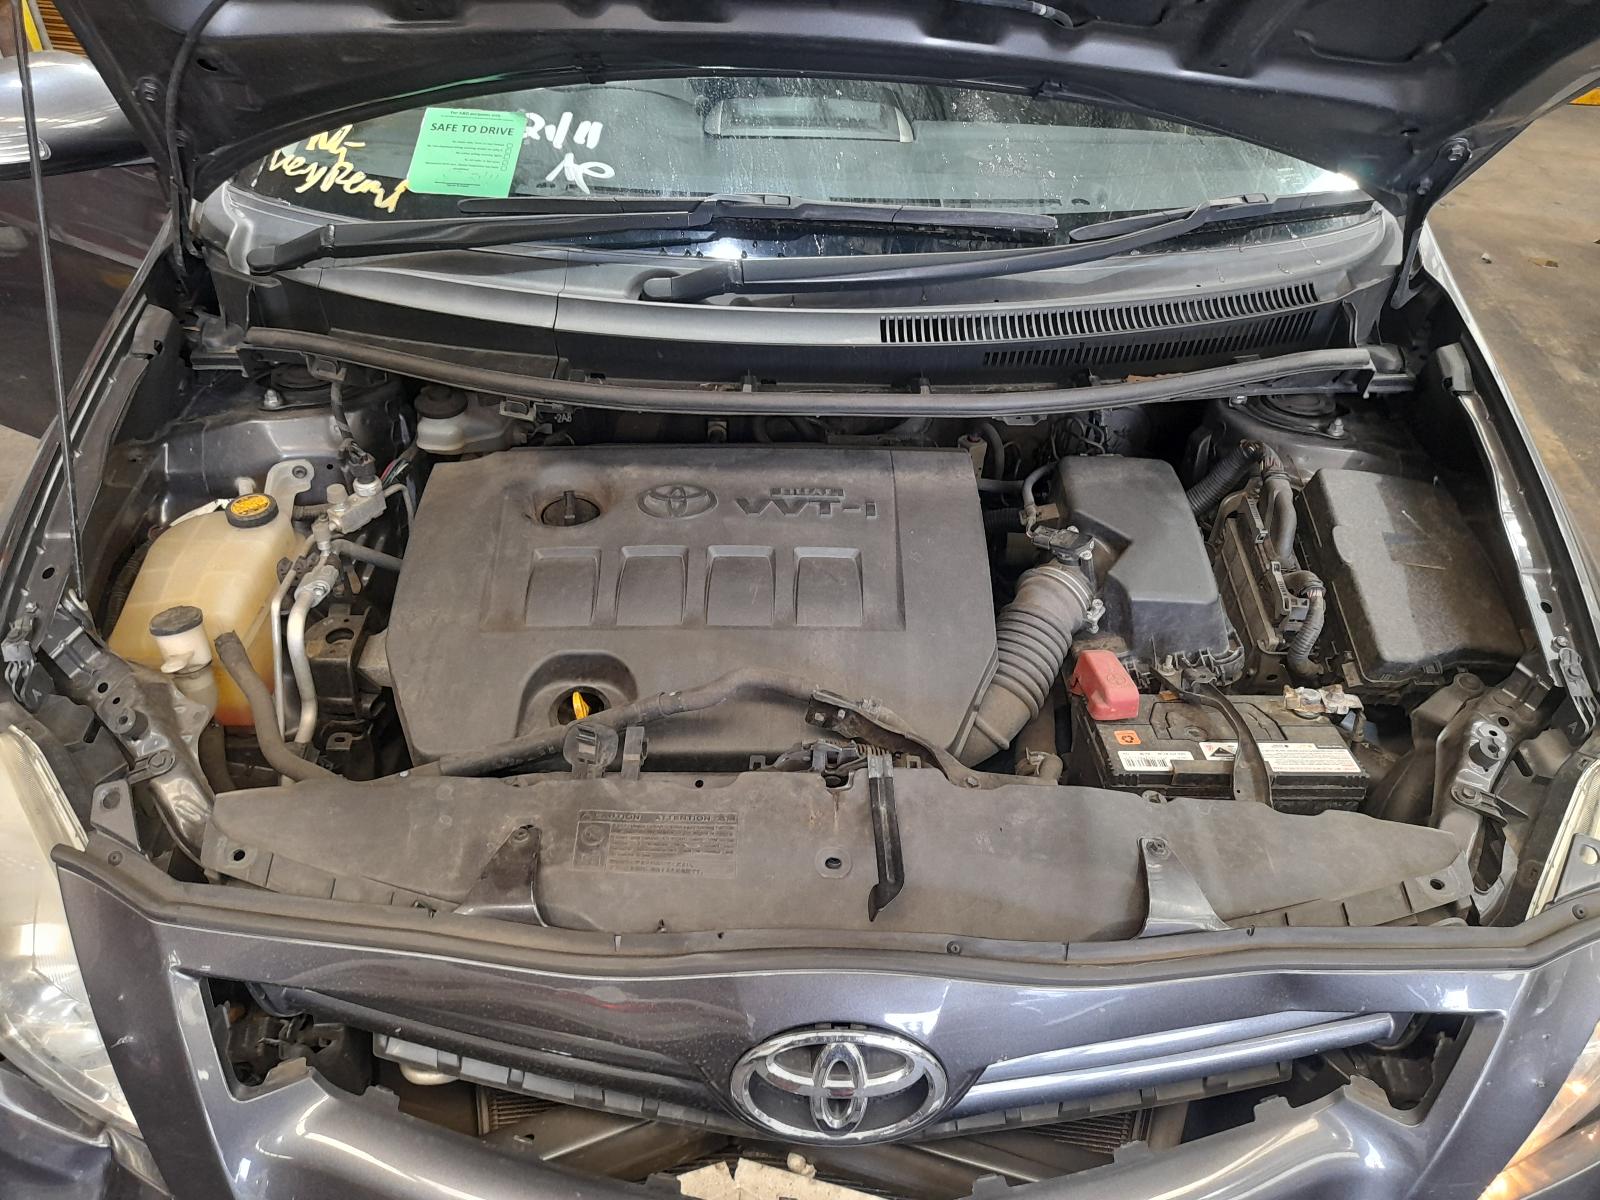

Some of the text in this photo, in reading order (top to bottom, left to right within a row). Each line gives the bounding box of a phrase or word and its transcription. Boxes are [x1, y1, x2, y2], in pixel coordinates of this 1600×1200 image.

[430, 122, 516, 136] SAFE TO DRIVE
